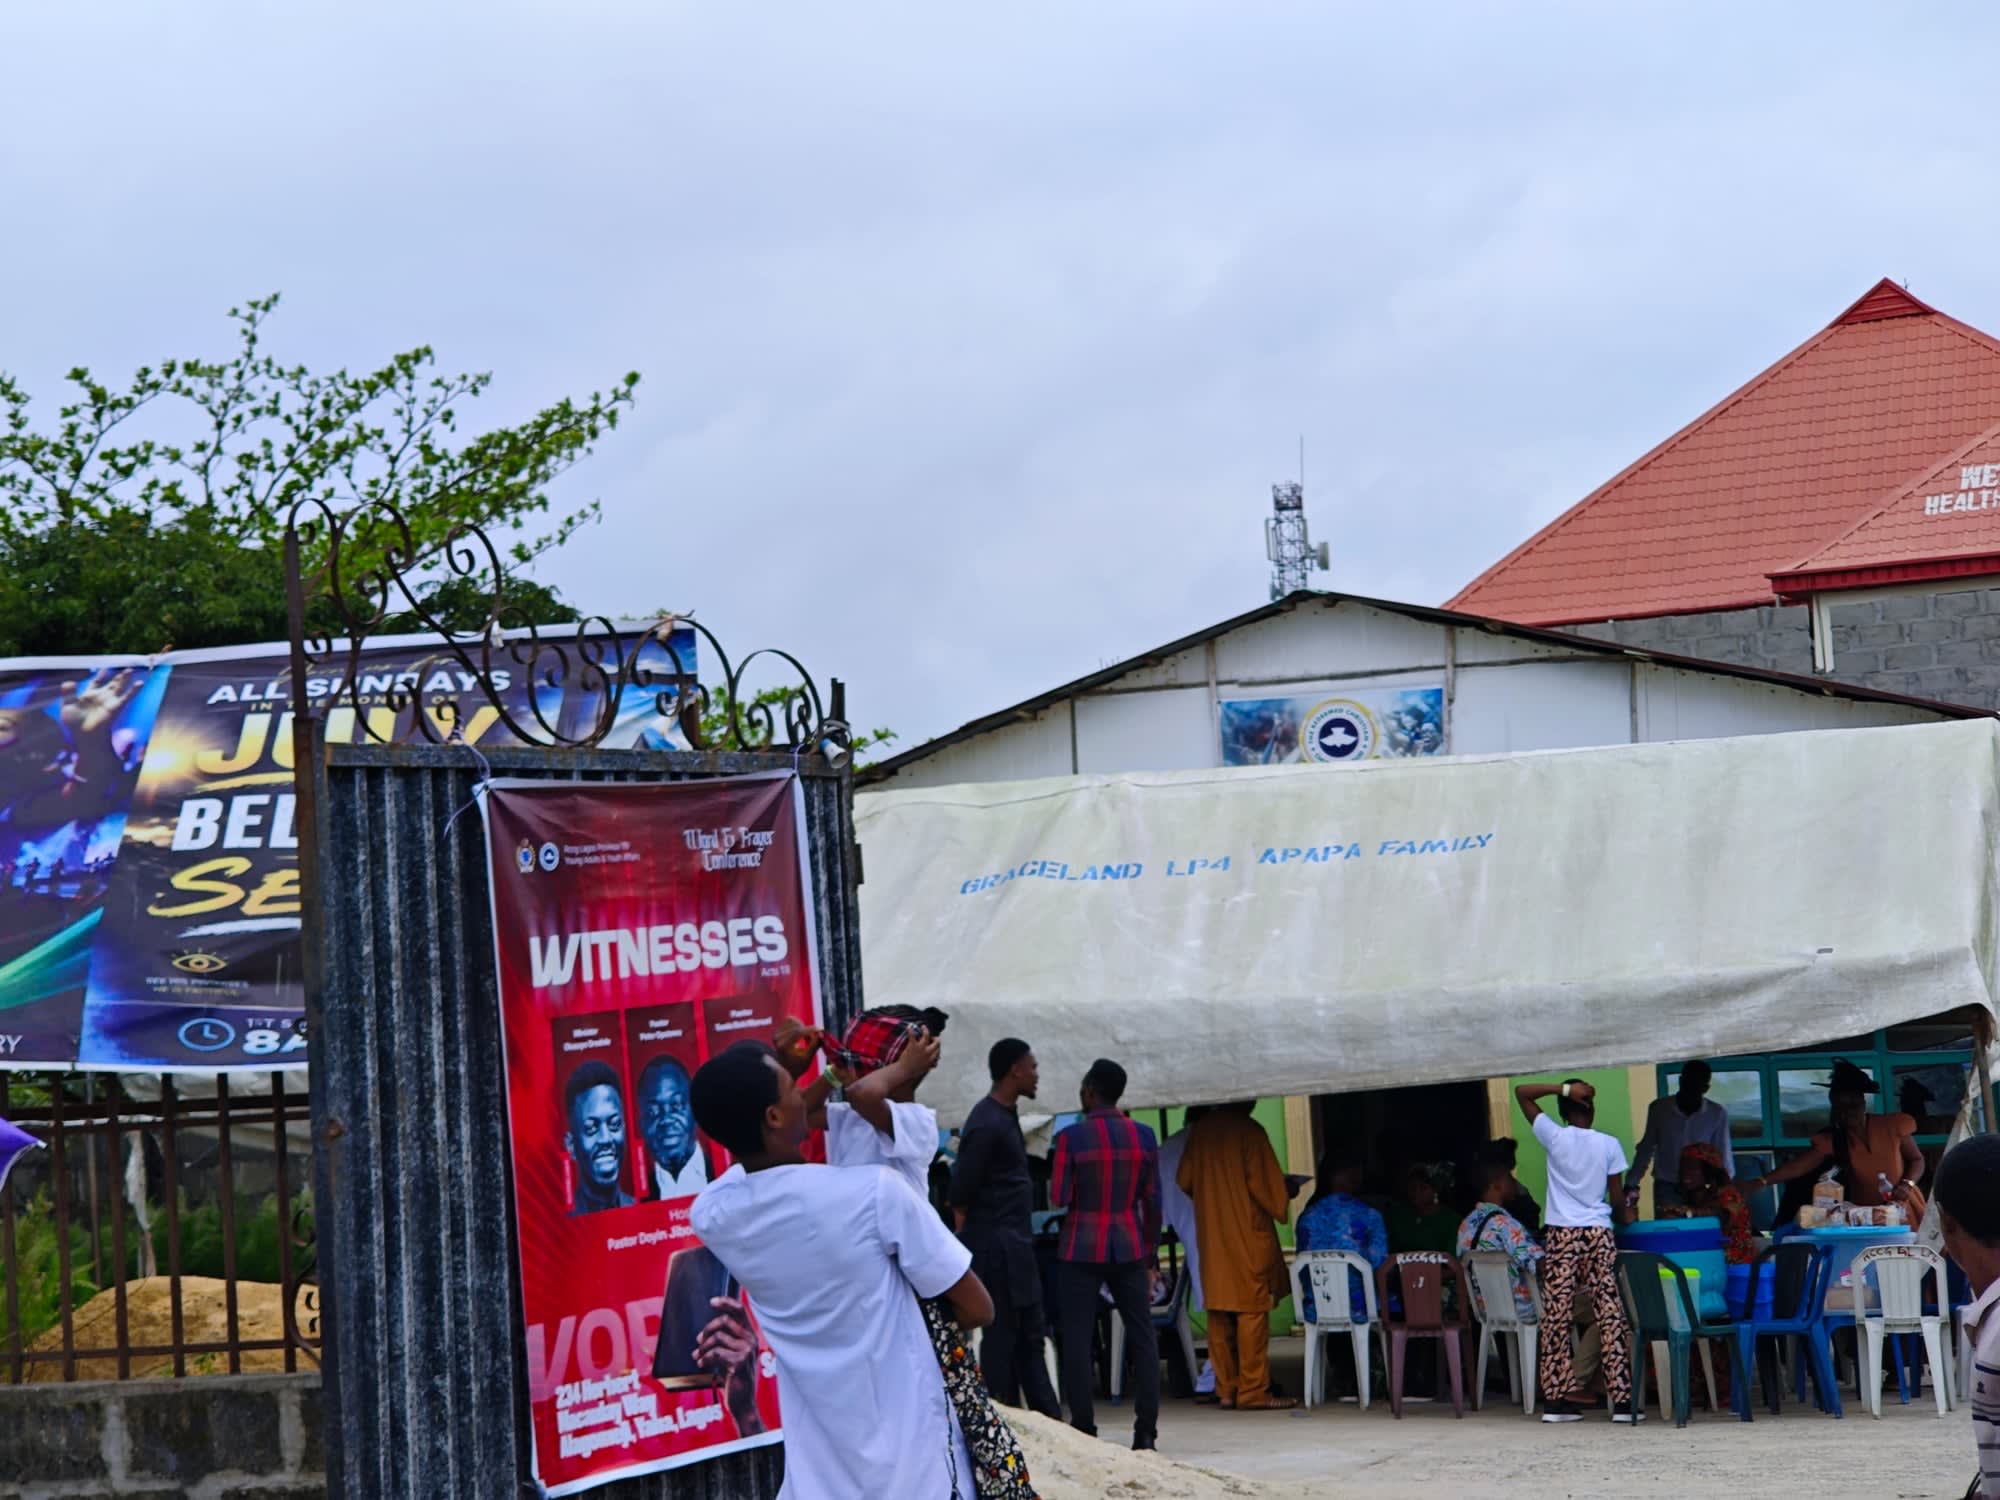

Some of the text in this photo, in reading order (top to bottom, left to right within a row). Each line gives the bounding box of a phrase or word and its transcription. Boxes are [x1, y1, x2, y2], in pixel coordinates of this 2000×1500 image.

[207, 670, 511, 704] ALL SUNDAYS
[1257, 842, 1361, 865] APAPA
[1378, 833, 1494, 856] FAMILY
[529, 915, 788, 989] WITNESSES
[676, 1403, 724, 1430] Lagos
